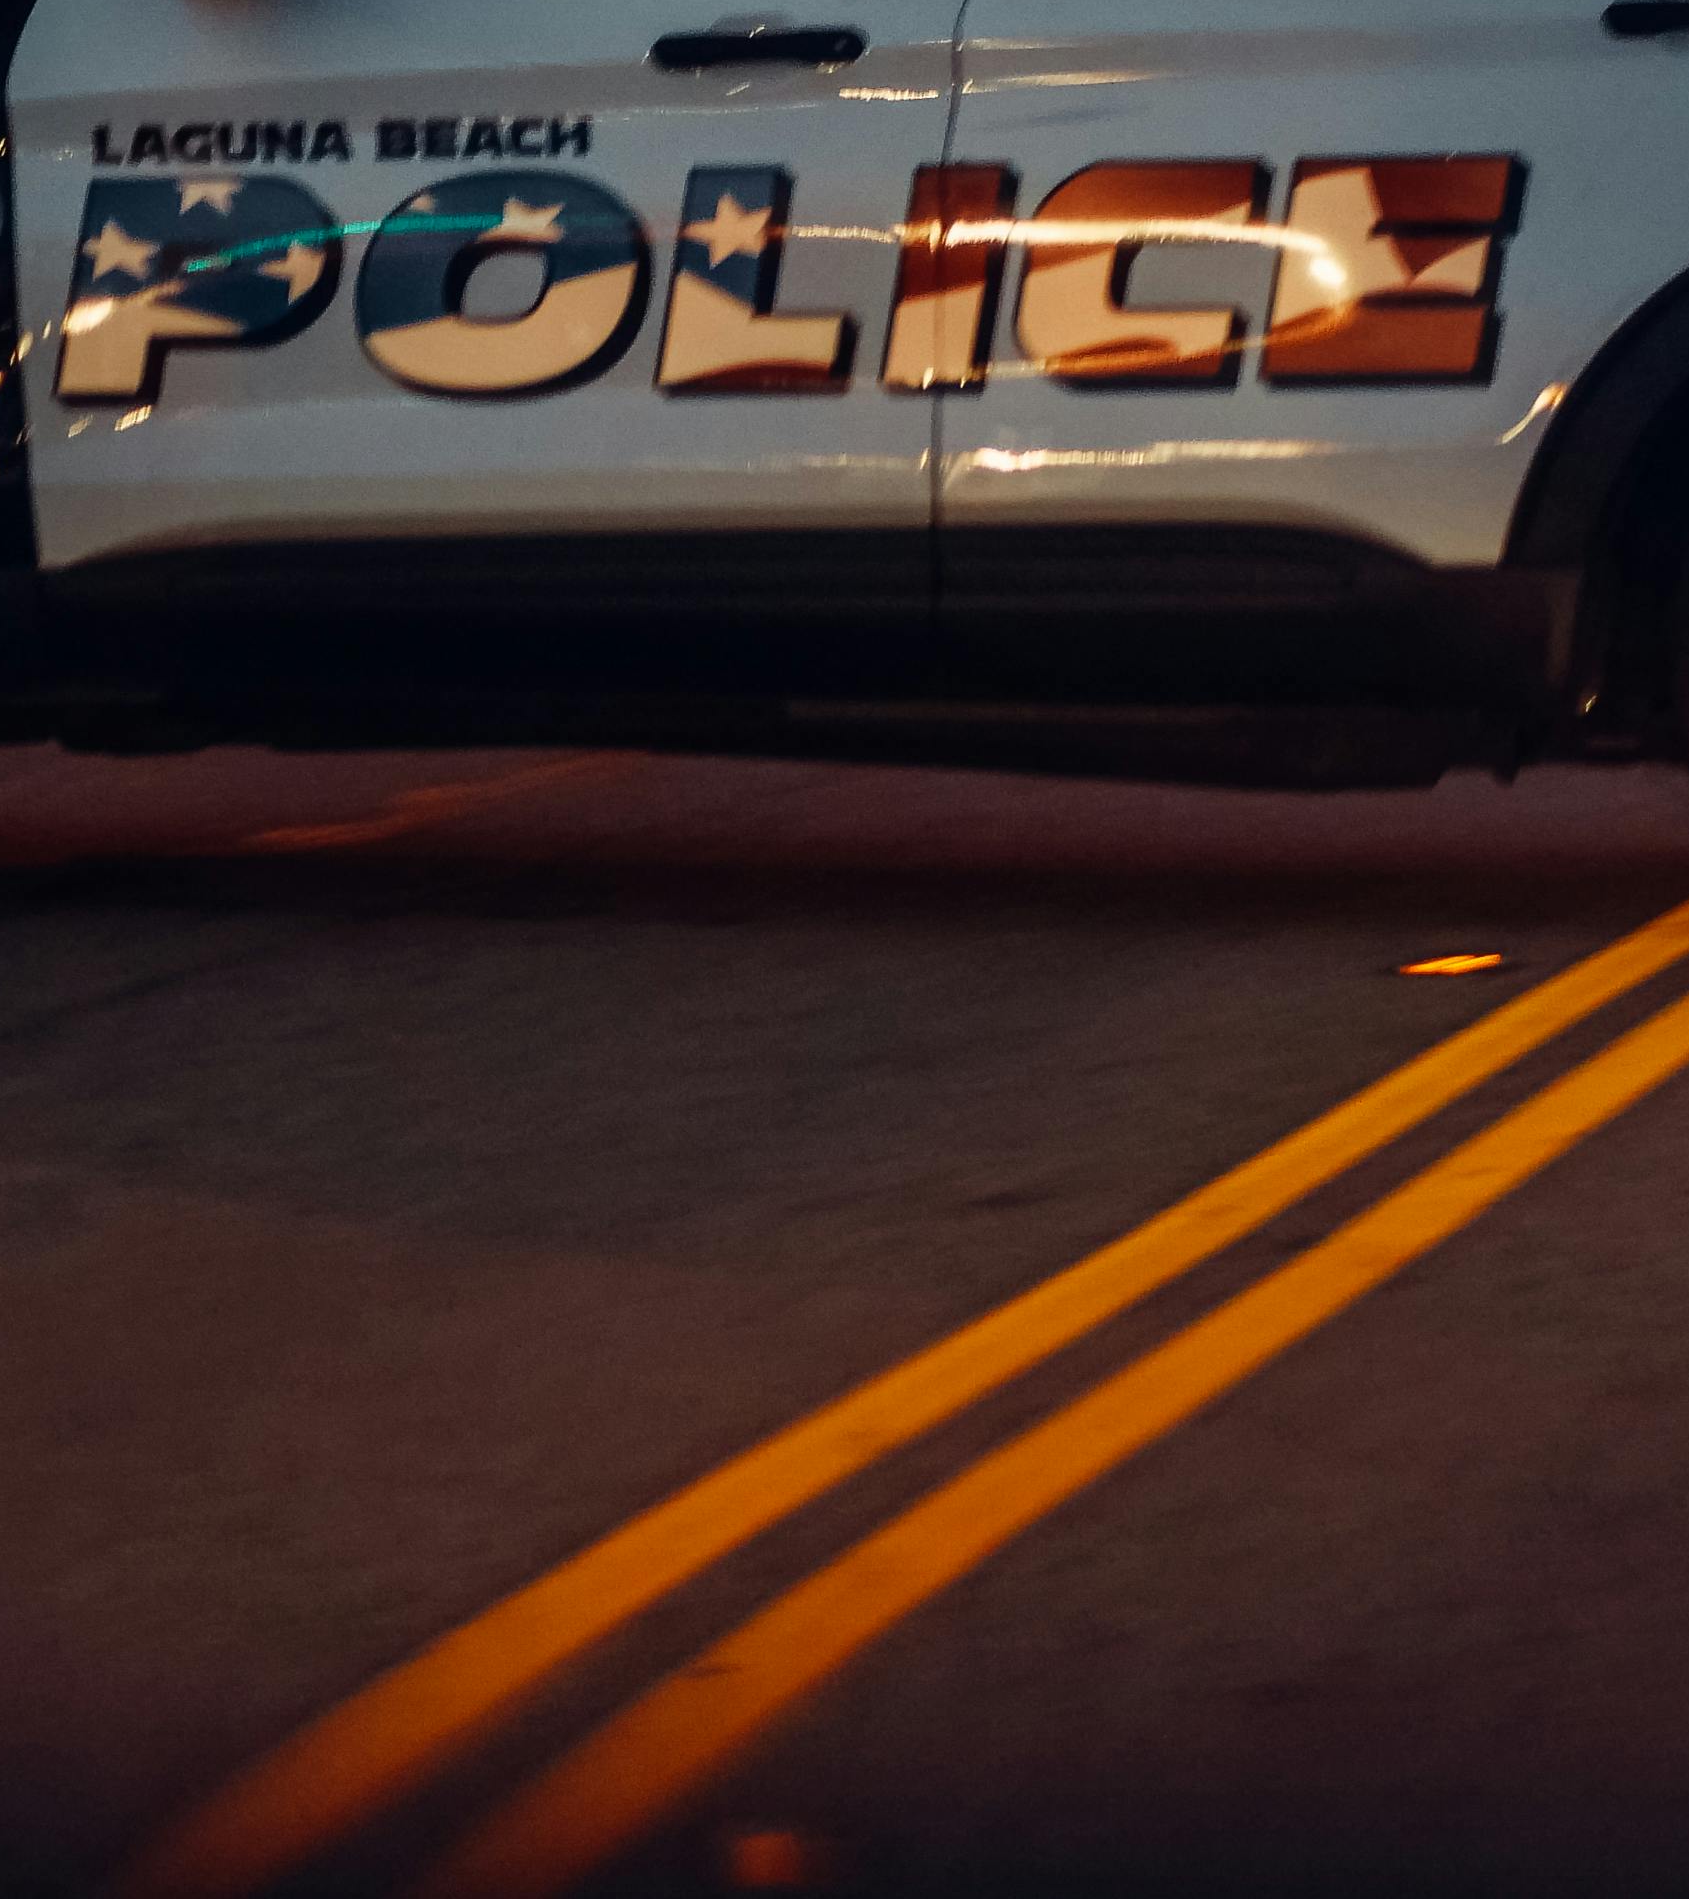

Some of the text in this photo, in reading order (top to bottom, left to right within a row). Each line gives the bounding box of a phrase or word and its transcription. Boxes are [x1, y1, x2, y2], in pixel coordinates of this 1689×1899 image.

[91, 114, 593, 166] LAGUNA BEACH
[52, 150, 1532, 405] POLICE
